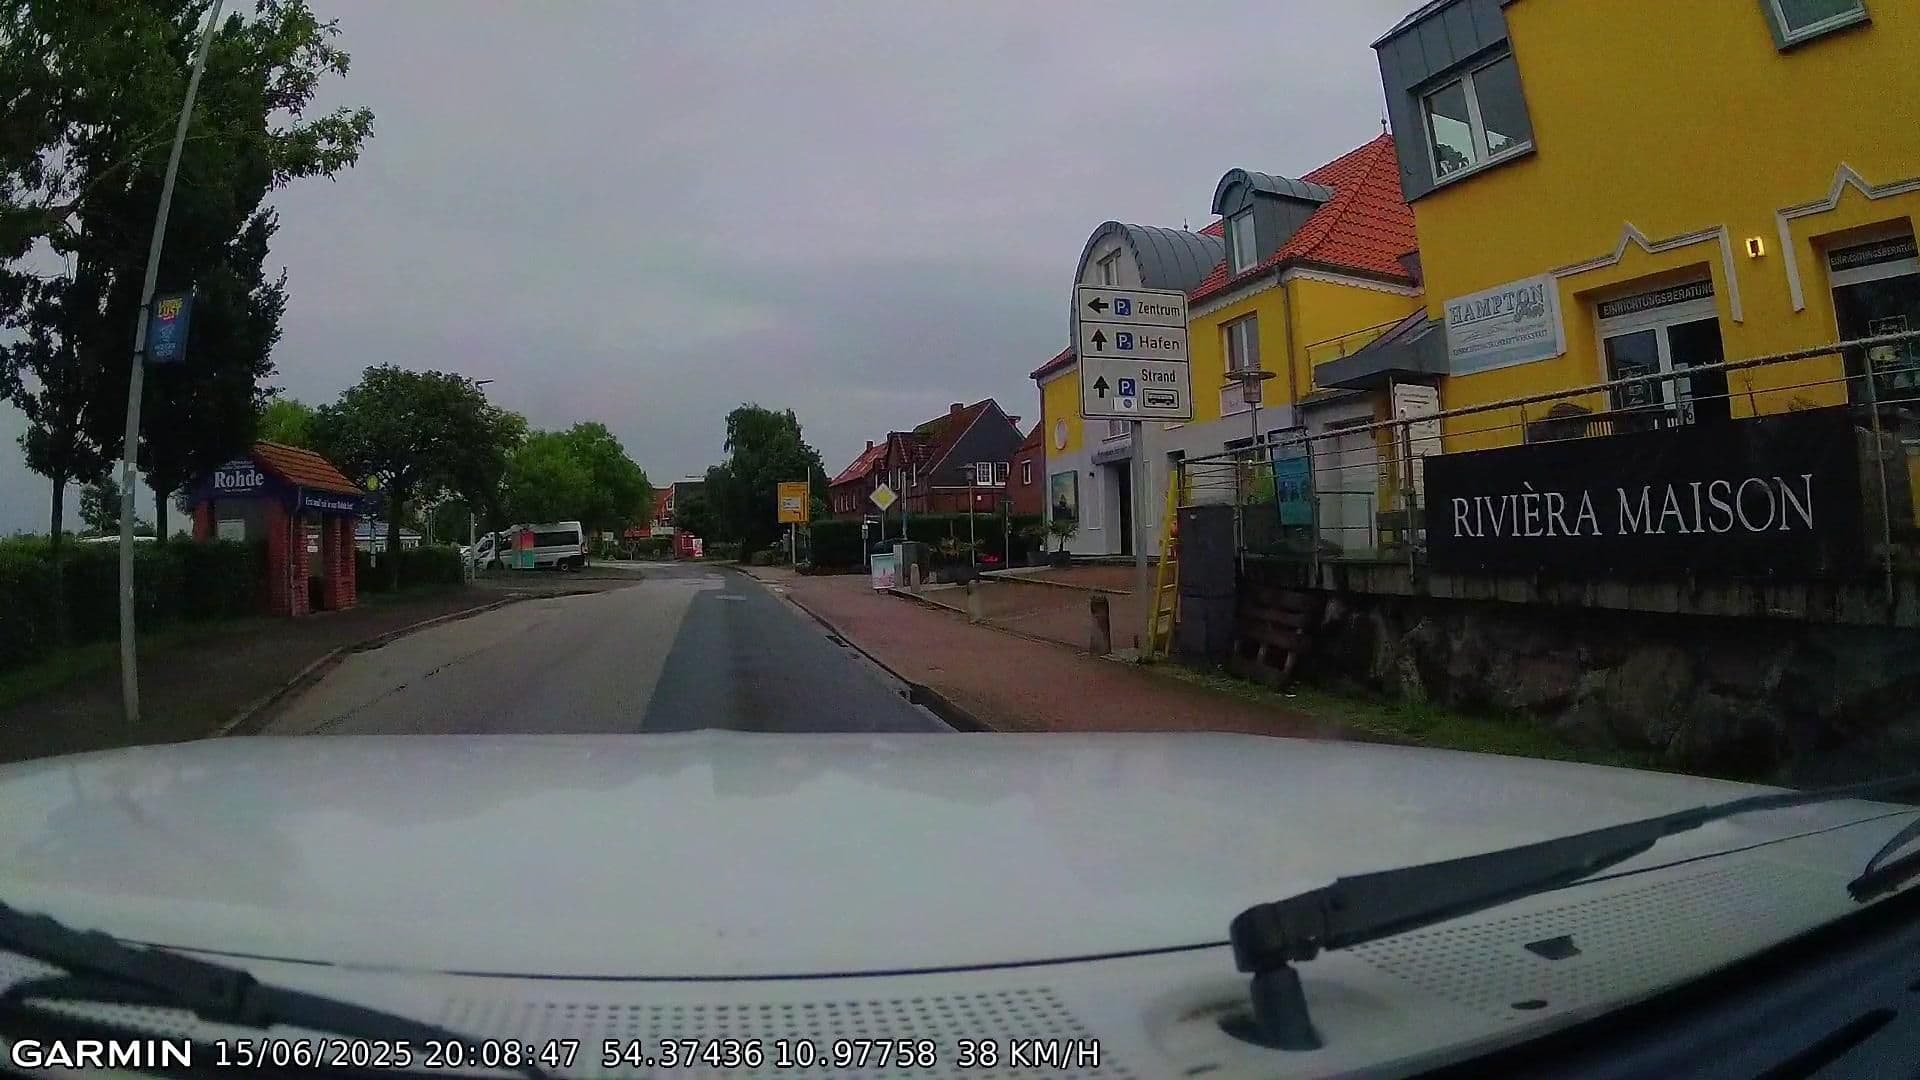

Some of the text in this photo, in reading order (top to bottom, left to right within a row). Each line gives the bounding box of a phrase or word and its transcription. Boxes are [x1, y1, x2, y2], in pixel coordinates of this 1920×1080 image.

[1138, 301, 1180, 317] Zentrum
[1448, 284, 1545, 325] HAMPTON
[1140, 336, 1179, 350] Hafen
[1141, 368, 1175, 383] Strand
[214, 469, 265, 488] Rohde
[1451, 473, 1813, 537] RIVIÈRA MAISON
